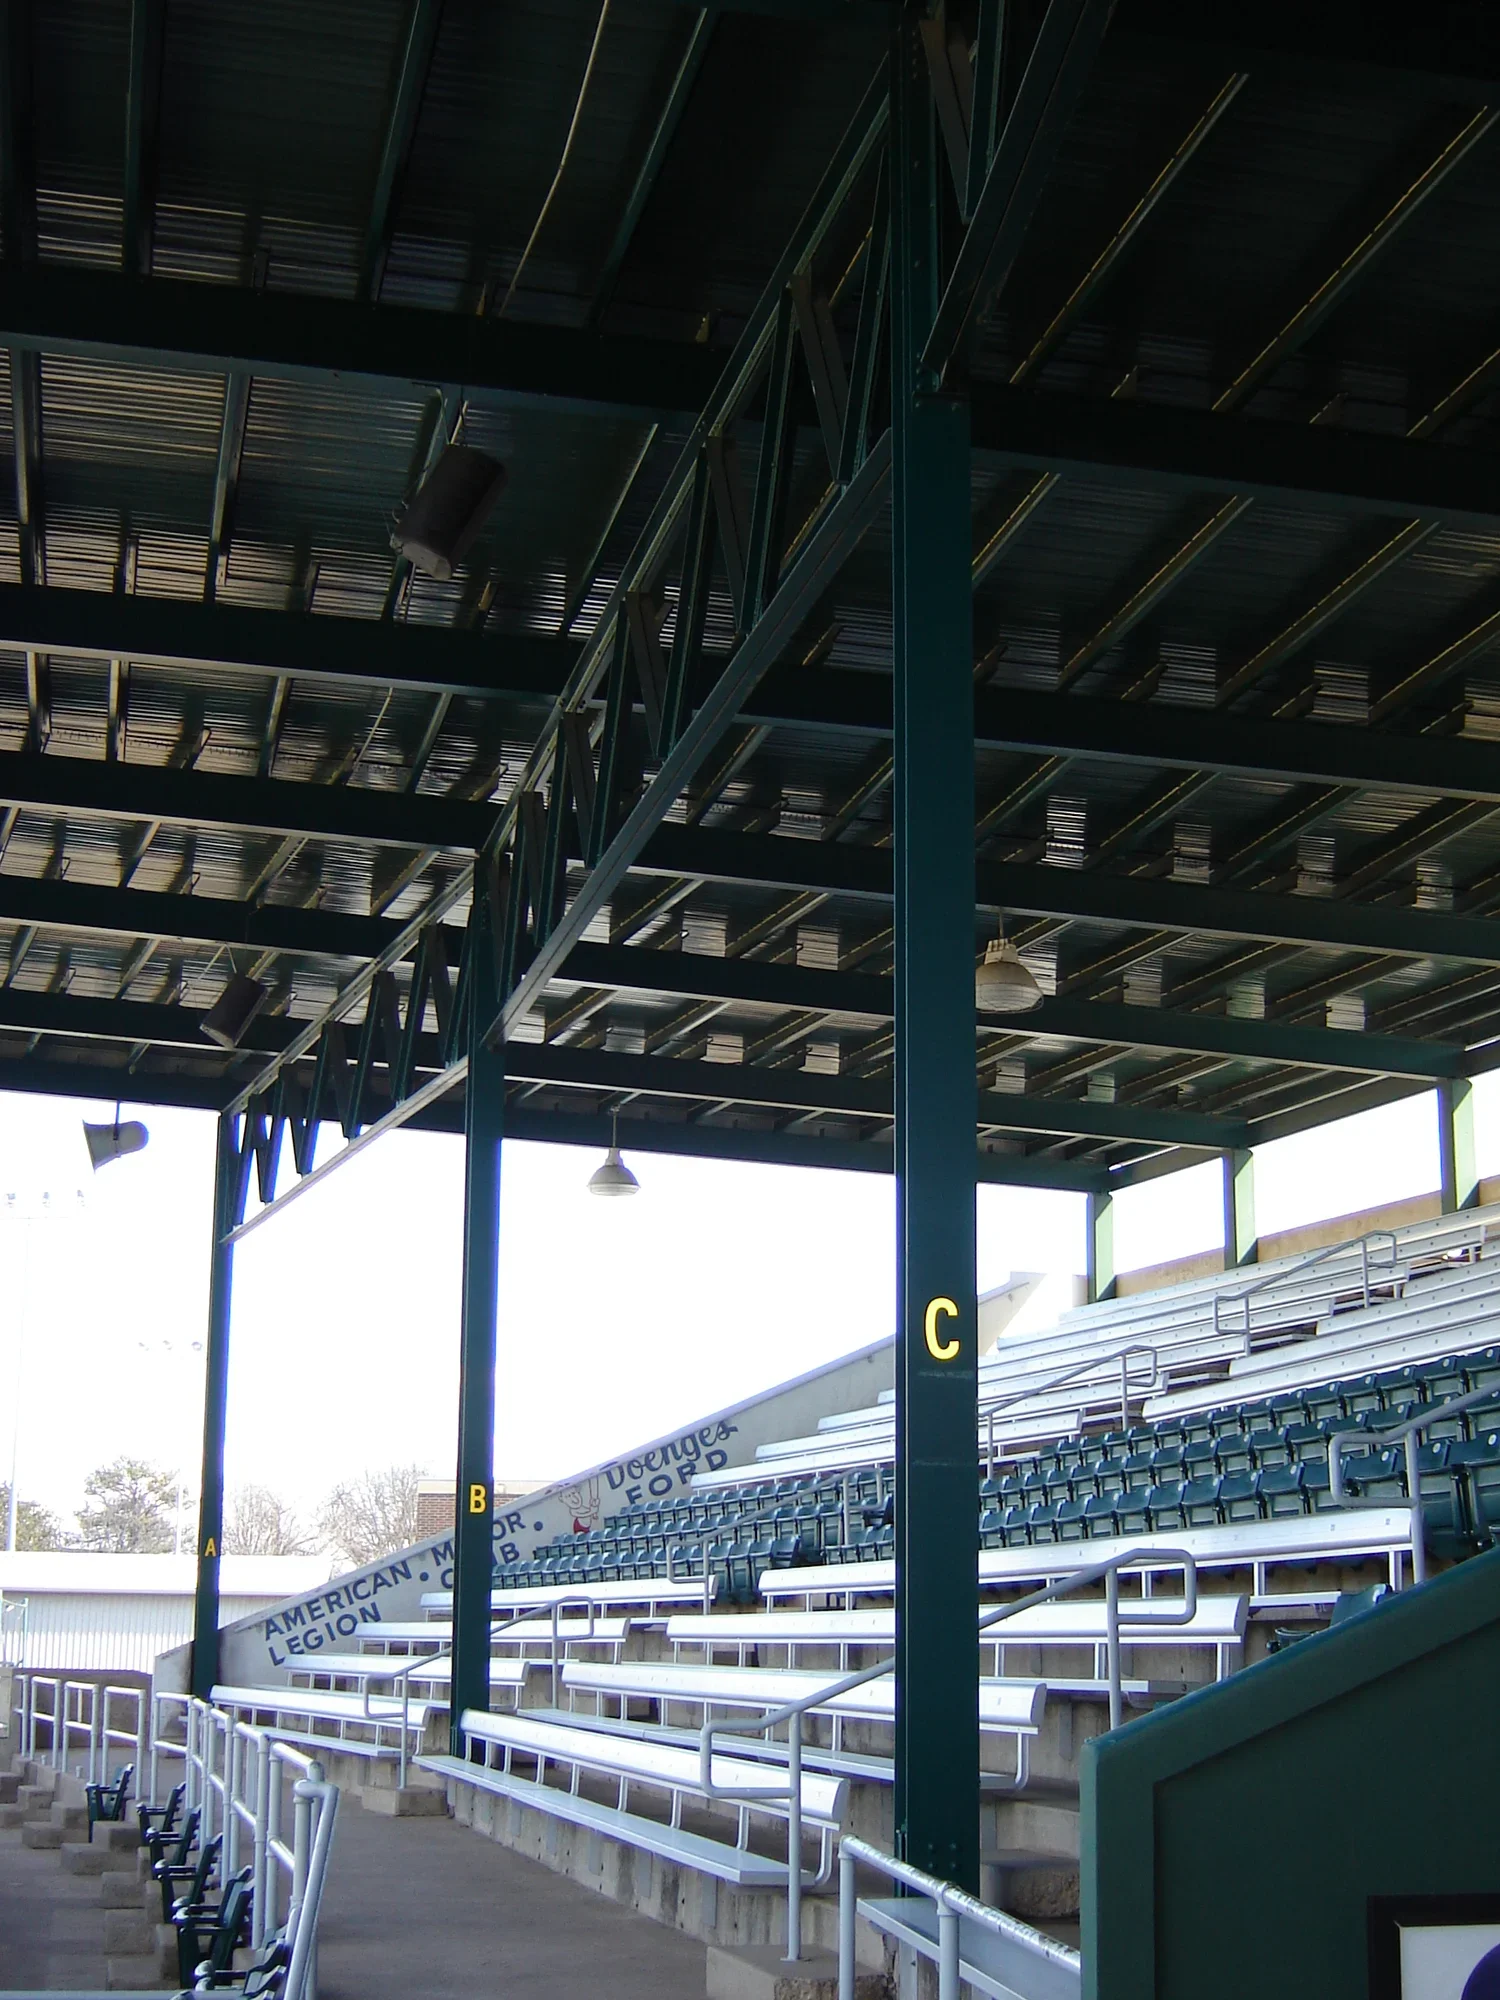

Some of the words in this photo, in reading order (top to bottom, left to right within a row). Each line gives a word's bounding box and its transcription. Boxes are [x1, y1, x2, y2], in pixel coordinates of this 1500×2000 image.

[924, 1296, 960, 1362] C
[469, 1483, 487, 1514] B
[625, 1449, 728, 1505] FORD
[204, 1537, 217, 1557] A
[431, 1511, 526, 1567] MOR
[265, 1560, 412, 1641] AMERICAN
[268, 1602, 381, 1666] LEGION
